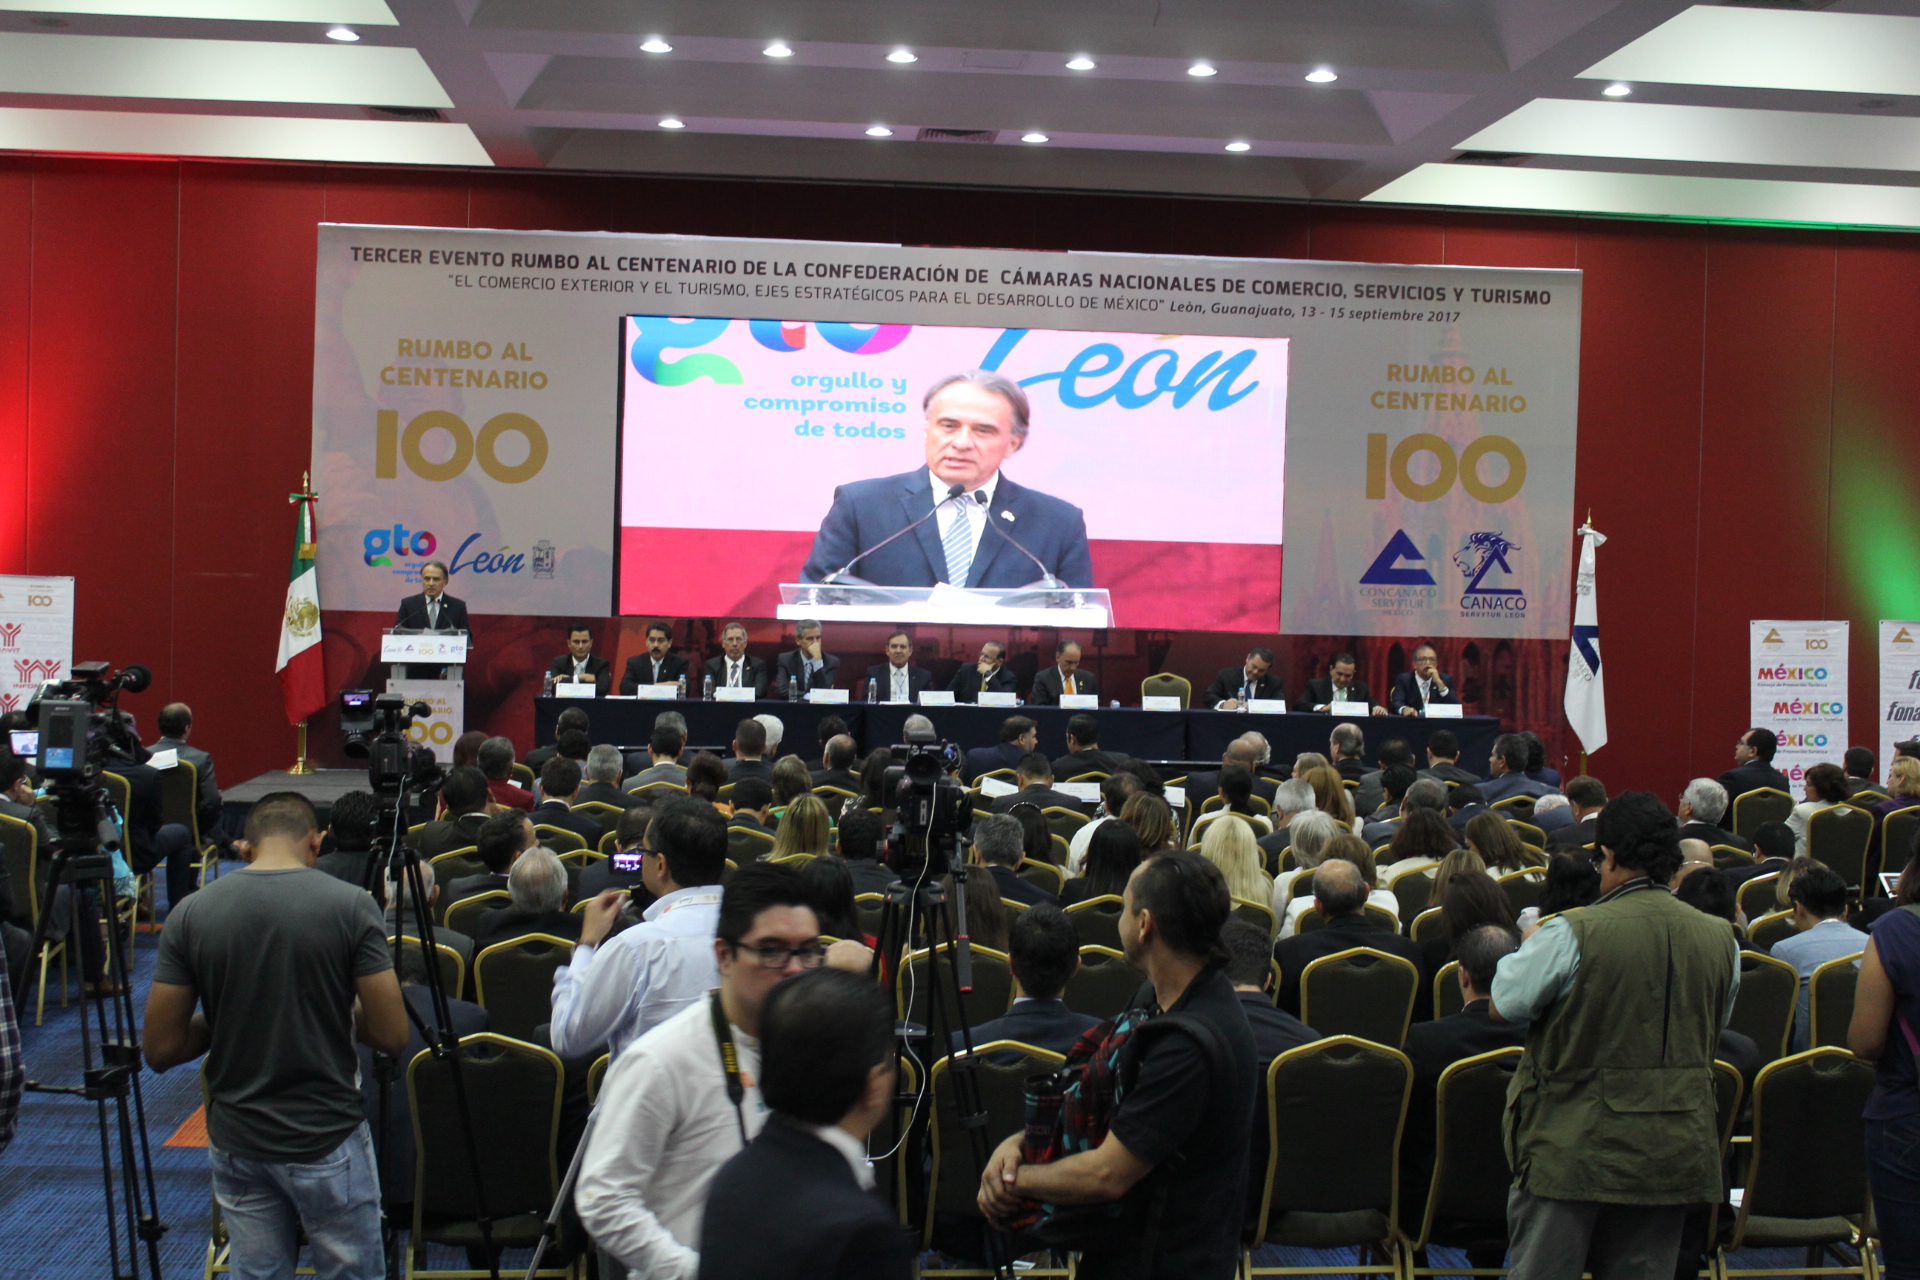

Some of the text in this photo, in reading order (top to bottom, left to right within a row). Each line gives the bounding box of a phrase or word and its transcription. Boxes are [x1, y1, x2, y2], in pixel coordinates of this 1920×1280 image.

[350, 246, 1551, 305] TERCER EVENTO RUMBO AL CENTENARIO DE LA CONFEDERACIÓN DE CÁMARAS NACIONALES DE COMERCIO, SERVICIOS Y TURISMO
[478, 275, 556, 291] COMERCIO
[561, 278, 634, 293] EXTERIOR
[640, 281, 649, 293] Y
[655, 281, 673, 294] EL
[678, 282, 750, 298] TURISMO,
[755, 285, 790, 298] EJES
[795, 285, 904, 302] ESTRATÉGICOS
[909, 290, 948, 304] PARA
[954, 292, 972, 305] EL
[977, 293, 1075, 308] DESARROLLO
[1080, 296, 1099, 309] DE
[1211, 302, 1296, 319] Guanajuato,
[1301, 307, 1316, 318] 13
[1330, 307, 1345, 319] 15
[1349, 308, 1424, 323] septiembre
[1427, 311, 1461, 323] 2017
[398, 338, 533, 361] RUMBO AL
[380, 366, 548, 390] CENTENARIO
[791, 371, 907, 396] orgullo y
[1387, 364, 1513, 385] RUMBO AL
[744, 397, 907, 416] compromiso
[1370, 391, 1527, 413] CENTENARIO
[794, 420, 906, 439] de todos
[375, 409, 549, 484] 100
[1365, 433, 1527, 504] 100
[363, 524, 437, 567] gto
[449, 533, 525, 575] León
[27, 595, 53, 607] 100
[1359, 588, 1437, 598] CONCANACO
[1371, 599, 1424, 608] SERVYTUR
[1460, 596, 1527, 611] CANACO
[1805, 639, 1829, 650] 100
[1886, 701, 1920, 721] fona
[404, 721, 453, 745] 00
